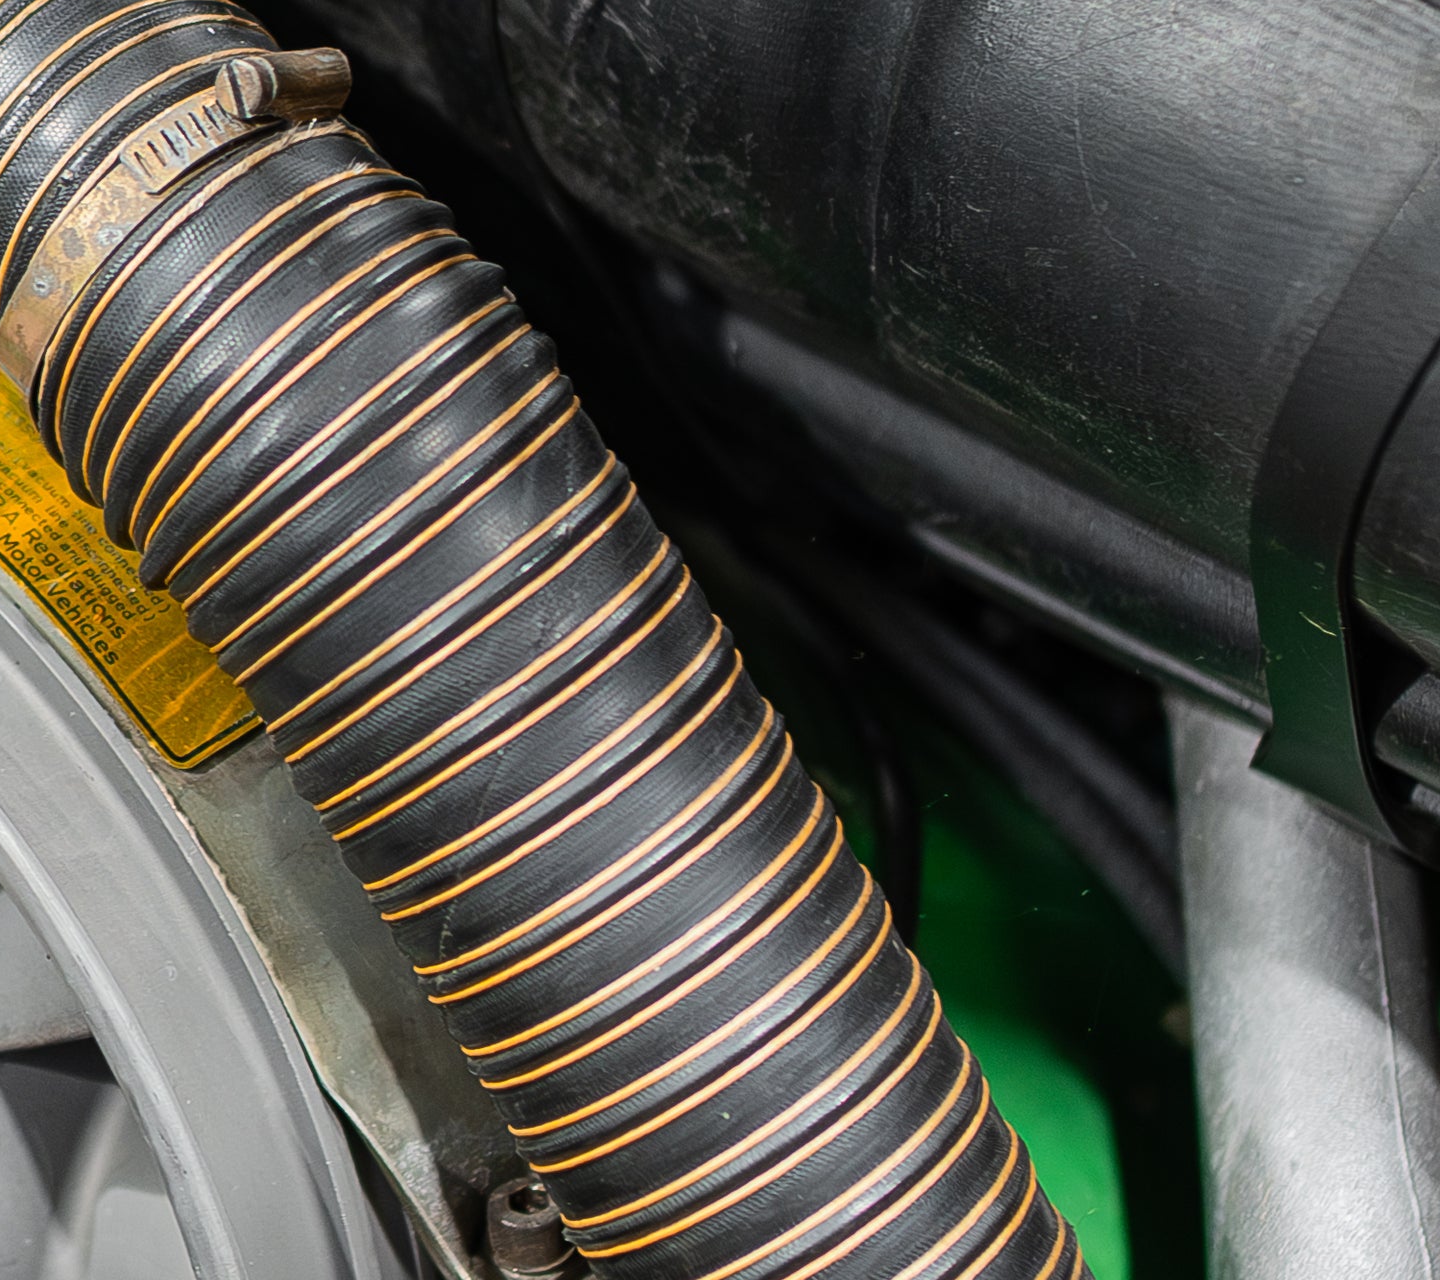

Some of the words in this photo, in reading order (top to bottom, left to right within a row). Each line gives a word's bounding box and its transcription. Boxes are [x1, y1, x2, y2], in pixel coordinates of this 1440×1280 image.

[44, 504, 70, 530] line
[19, 526, 129, 642] Regulations
[58, 539, 86, 568] and
[80, 565, 136, 623] plugged
[46, 582, 122, 666] Vehicles
